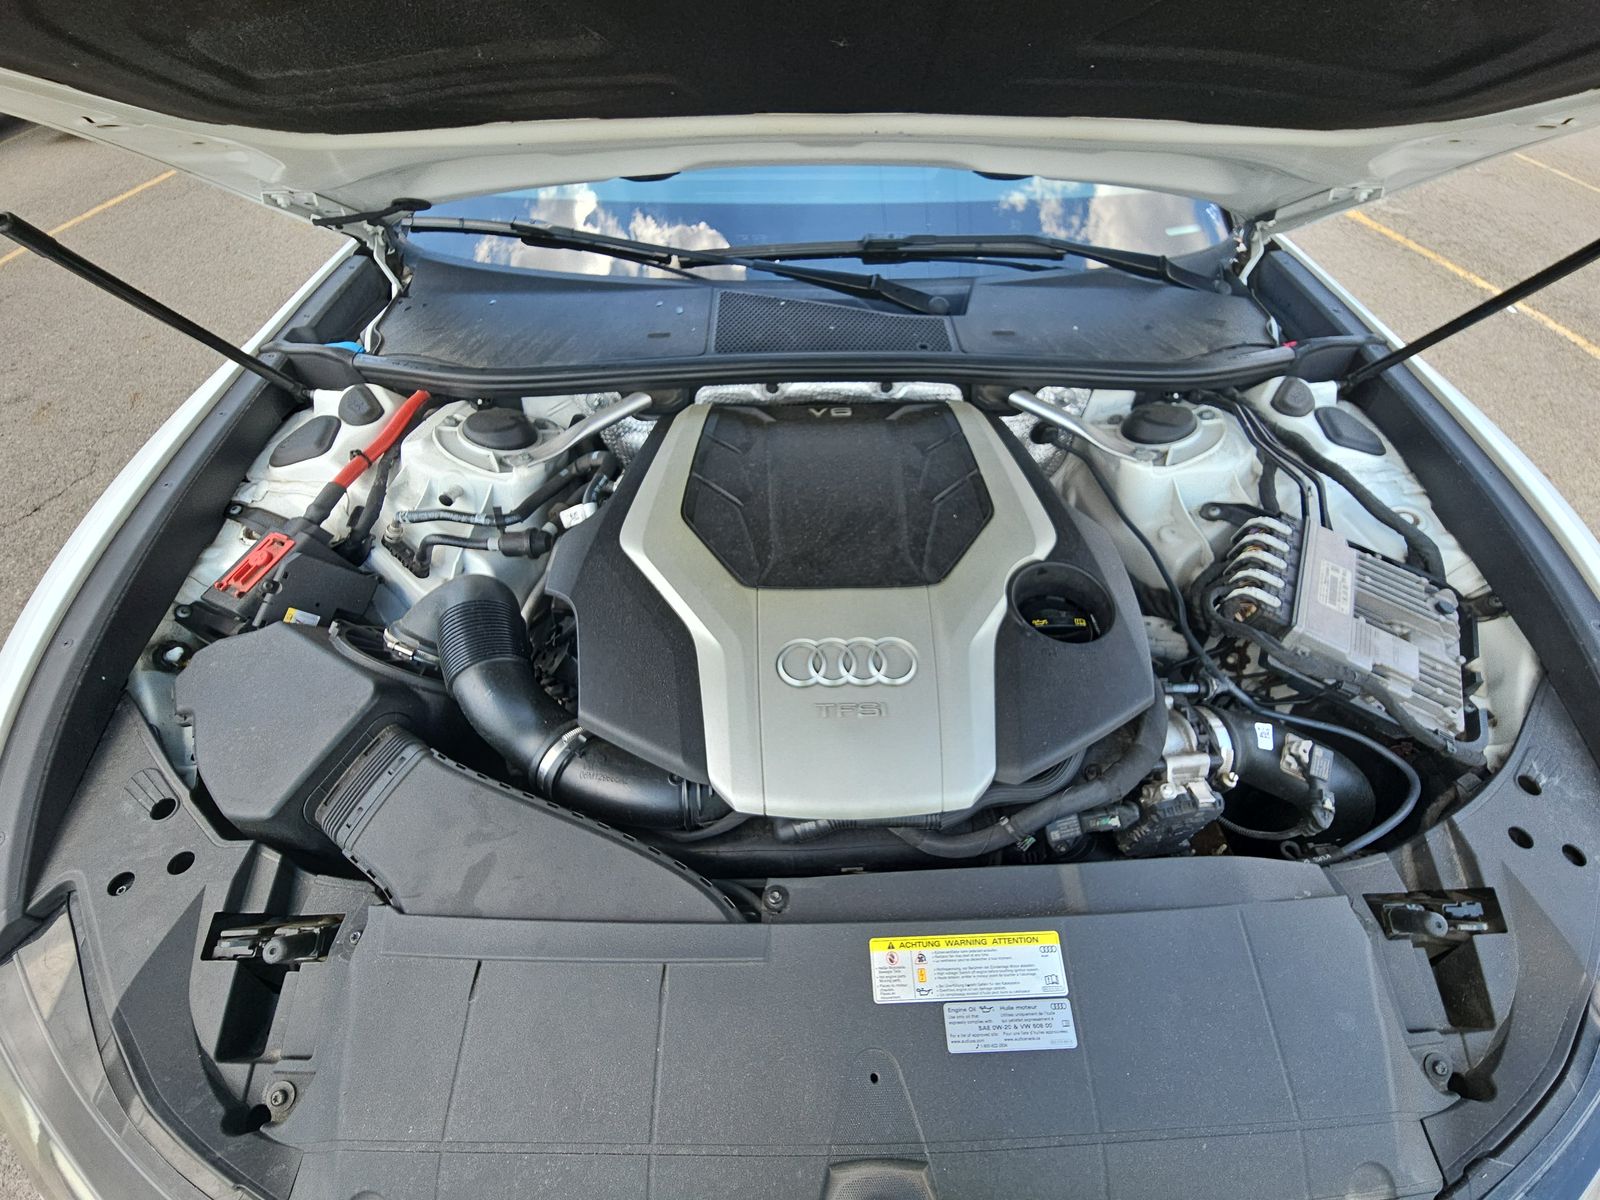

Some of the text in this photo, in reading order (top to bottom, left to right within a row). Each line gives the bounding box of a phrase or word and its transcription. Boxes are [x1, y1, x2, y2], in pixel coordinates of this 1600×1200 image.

[808, 407, 852, 417] V6
[814, 702, 888, 717] TFSI
[899, 936, 1039, 949] ACHTUNG WARNING ATTENTION
